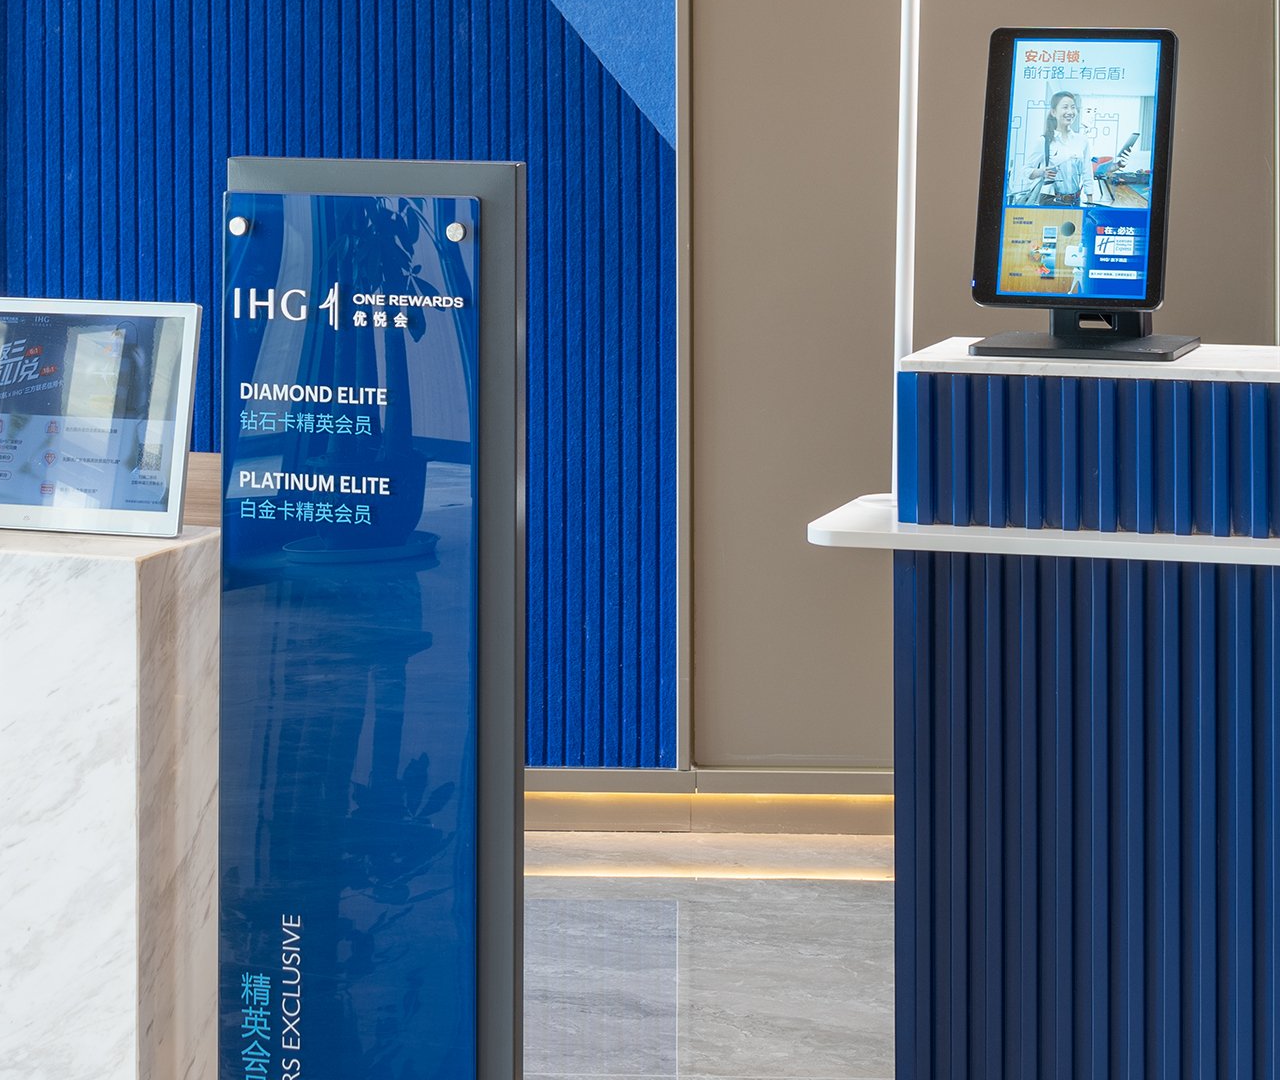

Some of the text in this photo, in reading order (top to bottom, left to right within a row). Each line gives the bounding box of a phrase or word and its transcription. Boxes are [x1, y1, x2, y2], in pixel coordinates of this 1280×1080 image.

[233, 287, 464, 321] IHG ONE REWARDS
[353, 310, 408, 329] 优悦会
[239, 383, 388, 406] DIAMOND ELITE
[239, 410, 372, 436] 钻石卡精英会员
[239, 471, 390, 495] PLATINUM ELITE
[240, 499, 372, 525] 白金卡精英会员
[282, 914, 301, 1050] EXCLUSIVE
[241, 972, 271, 1080] 精英会
